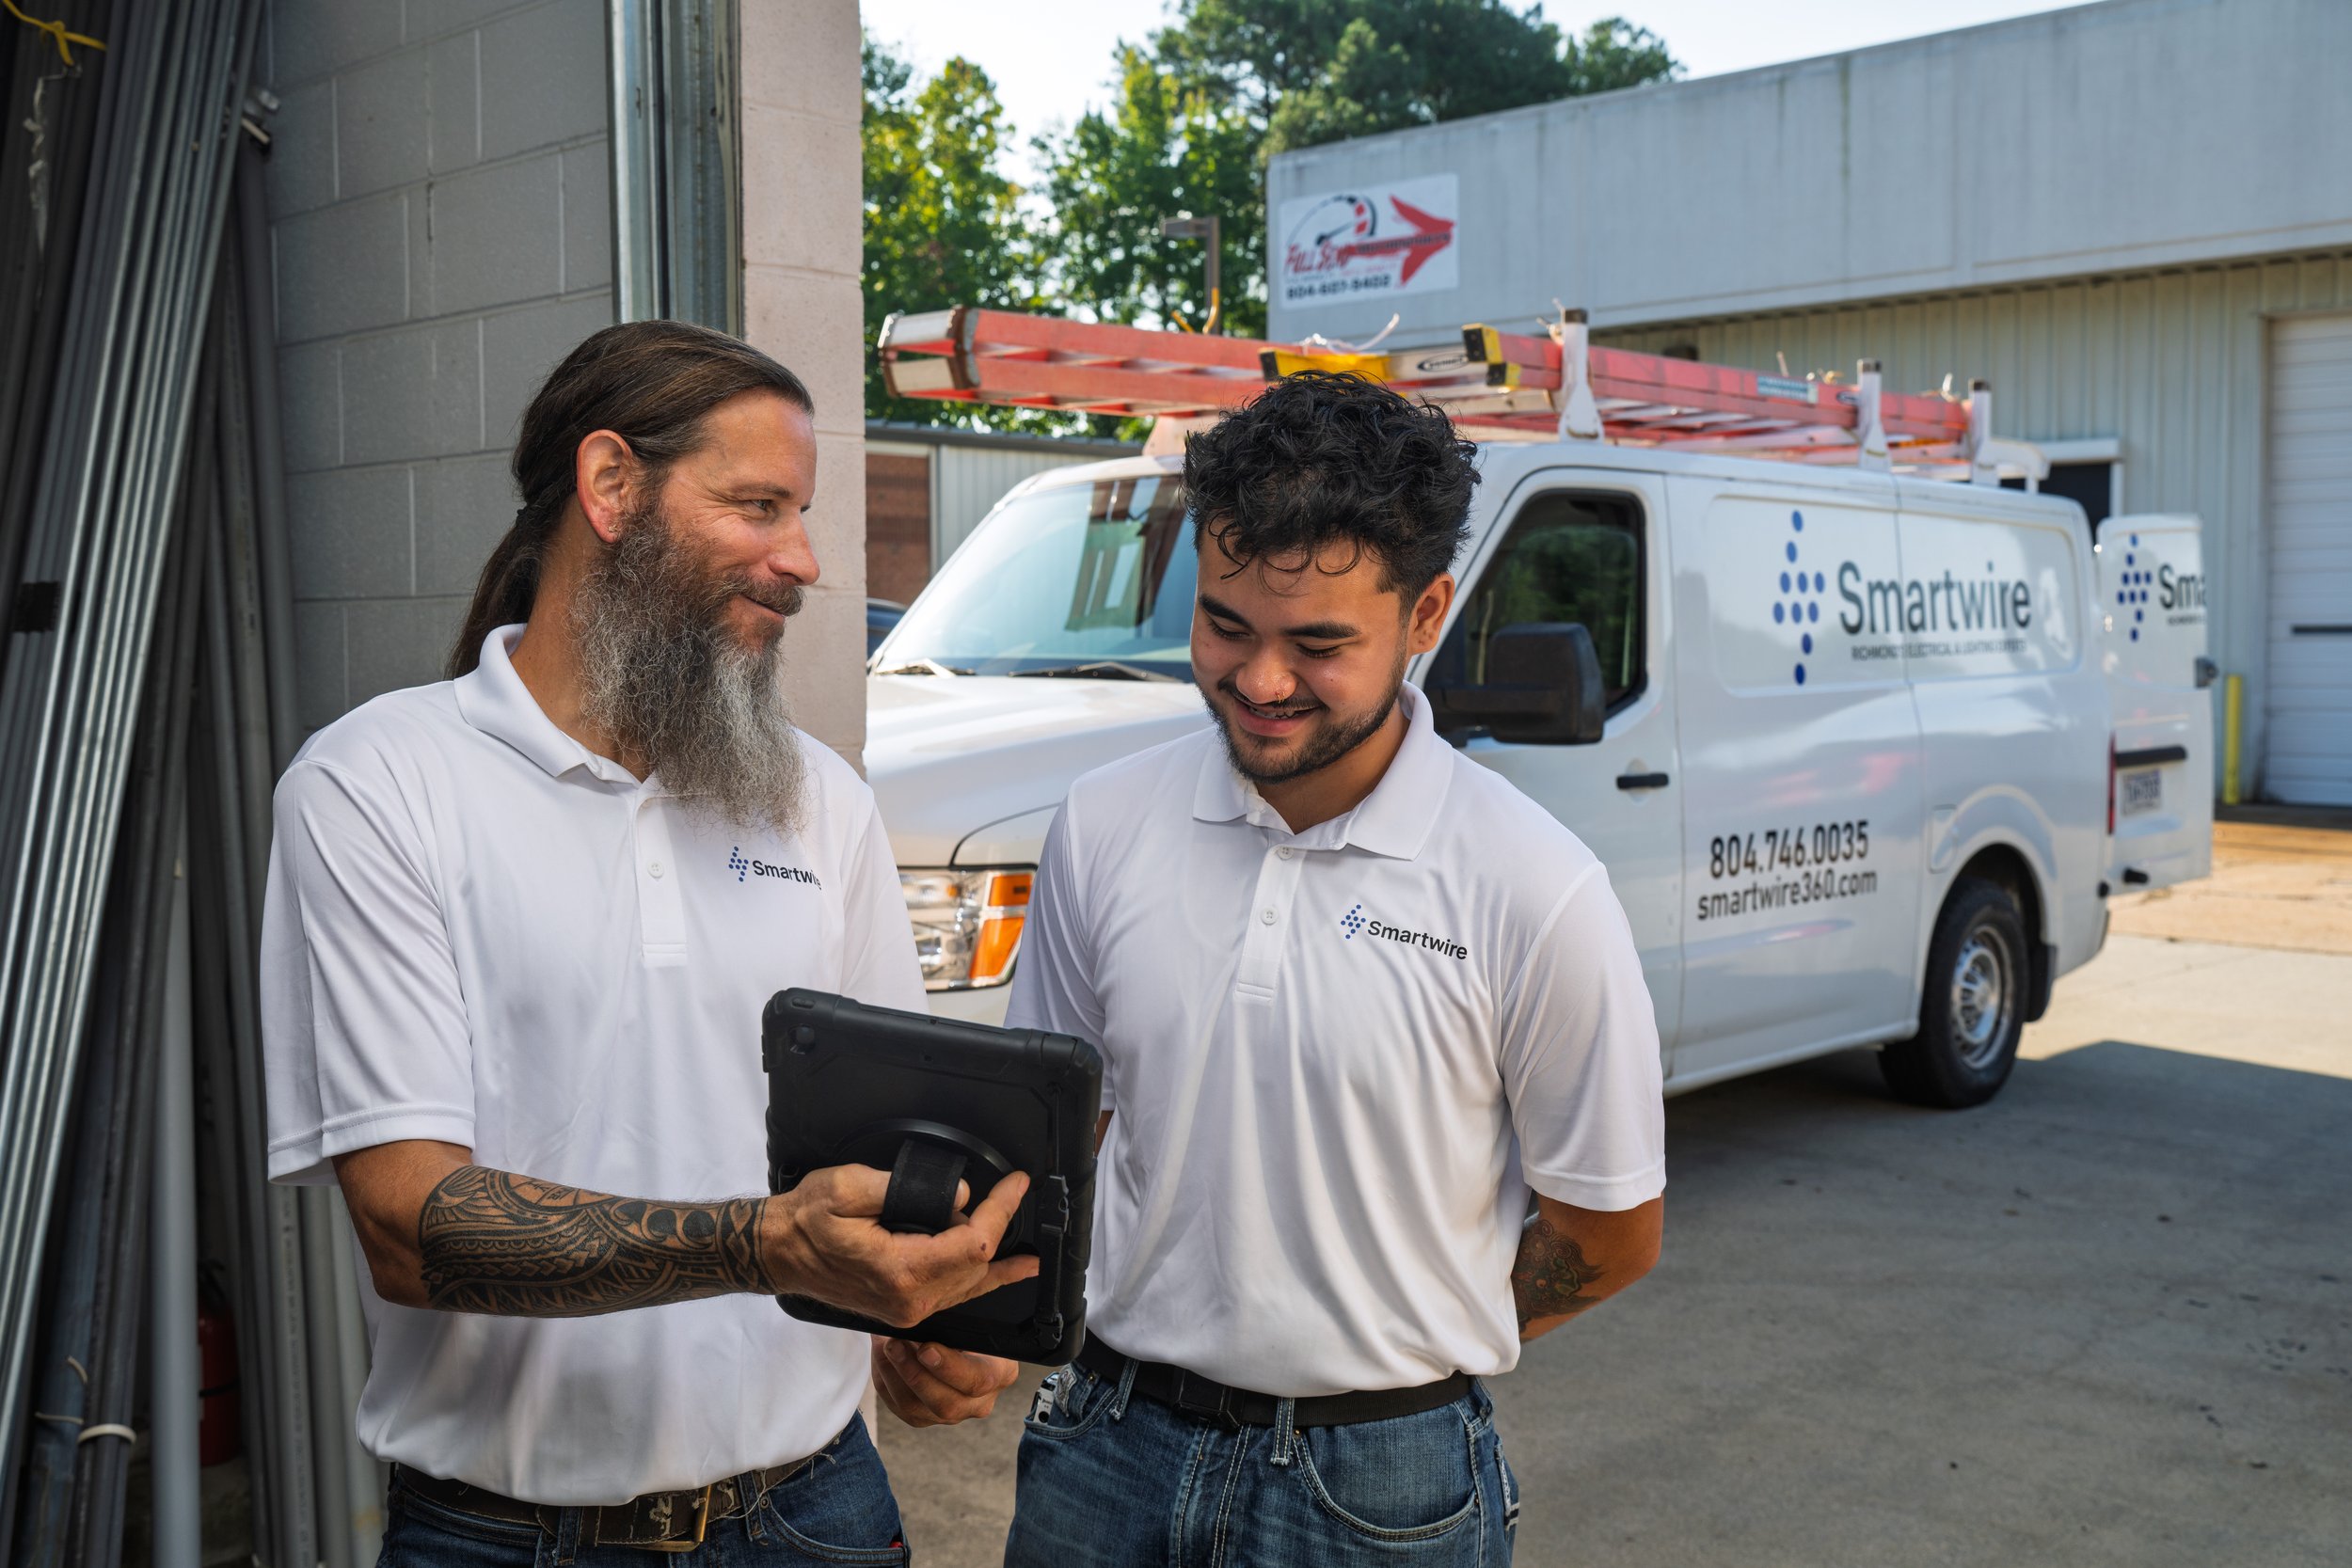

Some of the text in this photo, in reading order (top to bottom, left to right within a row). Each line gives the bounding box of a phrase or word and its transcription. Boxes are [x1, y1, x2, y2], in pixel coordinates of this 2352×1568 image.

[1838, 560, 2031, 636] Smartwire
[1710, 819, 1869, 879] 804.746.0035
[1697, 869, 1877, 921] smartwire360.com
[1367, 920, 1468, 960] Smartwire
